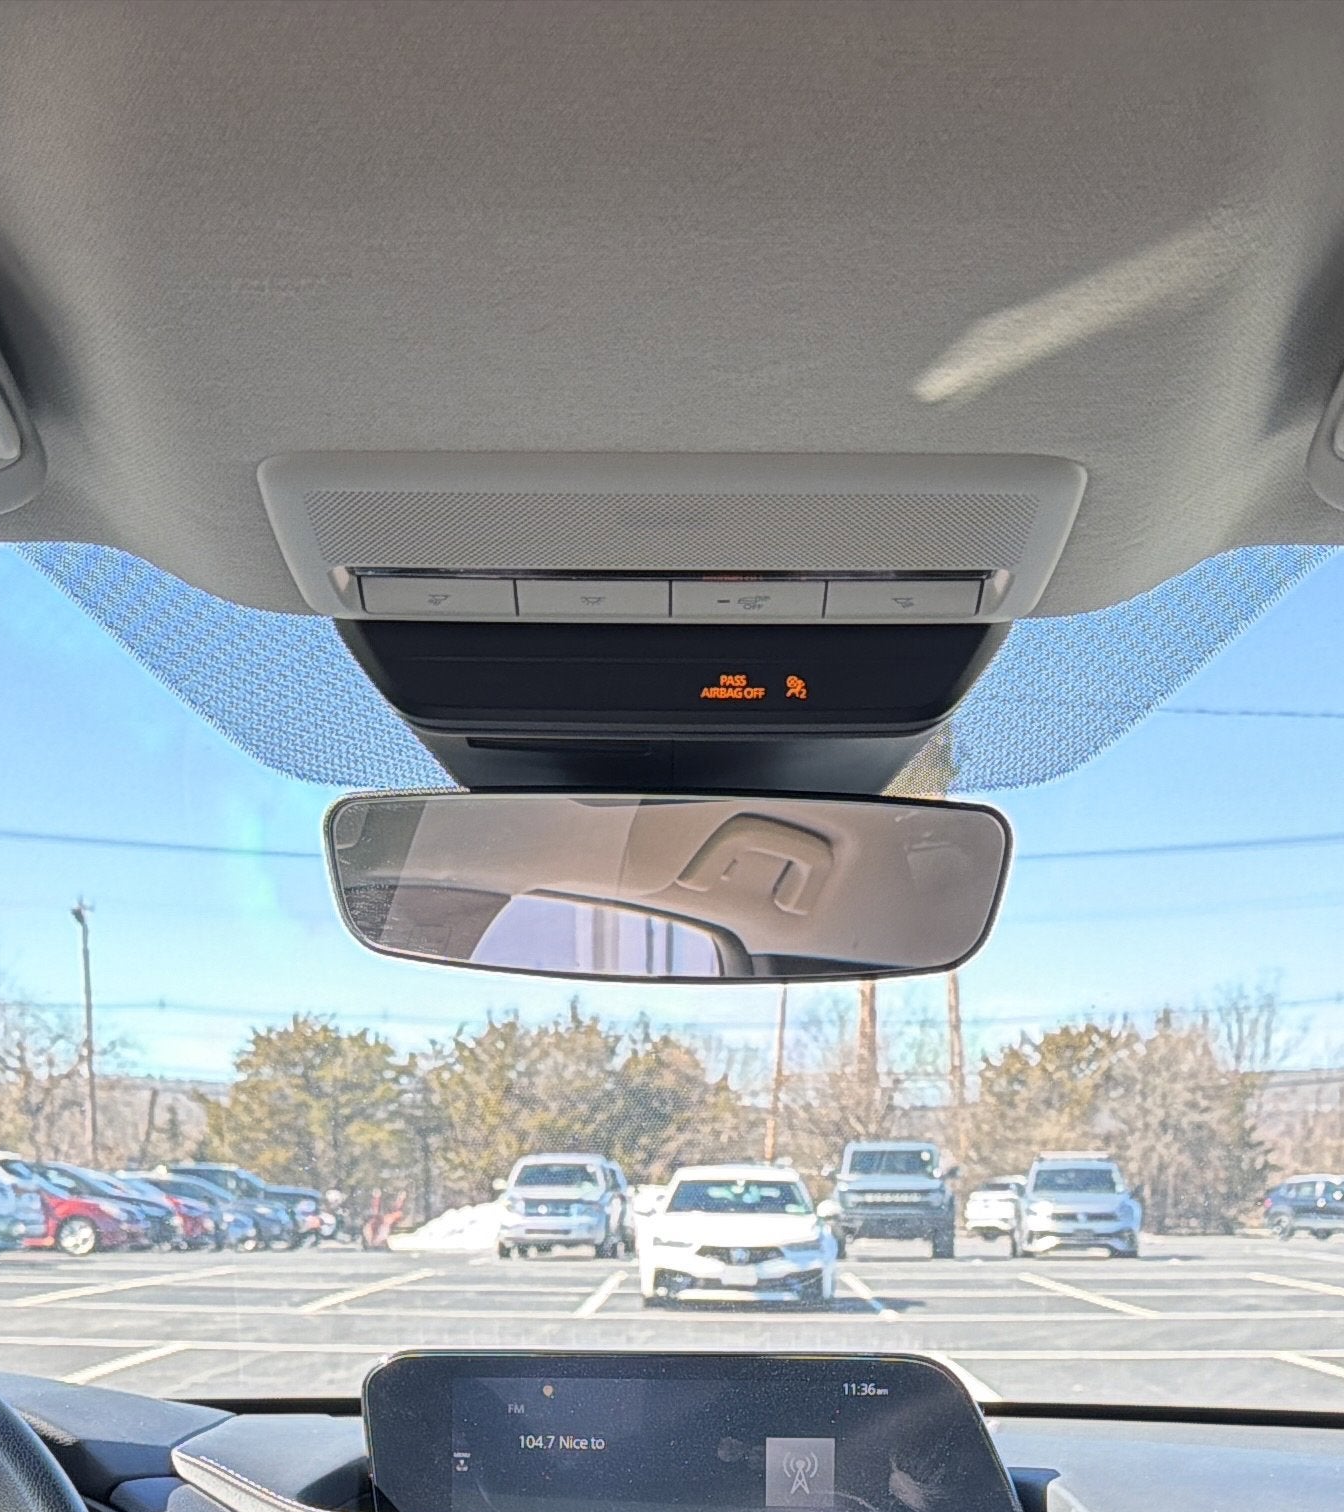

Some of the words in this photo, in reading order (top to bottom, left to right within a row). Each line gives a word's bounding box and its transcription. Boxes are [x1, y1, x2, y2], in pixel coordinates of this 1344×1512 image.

[719, 674, 747, 686] PASS
[700, 687, 743, 699] AIRBAG
[743, 687, 766, 699] OFF
[507, 1404, 525, 1414] FM
[518, 1435, 555, 1449] 104.7
[559, 1435, 588, 1450] Nice
[590, 1436, 605, 1450] to
